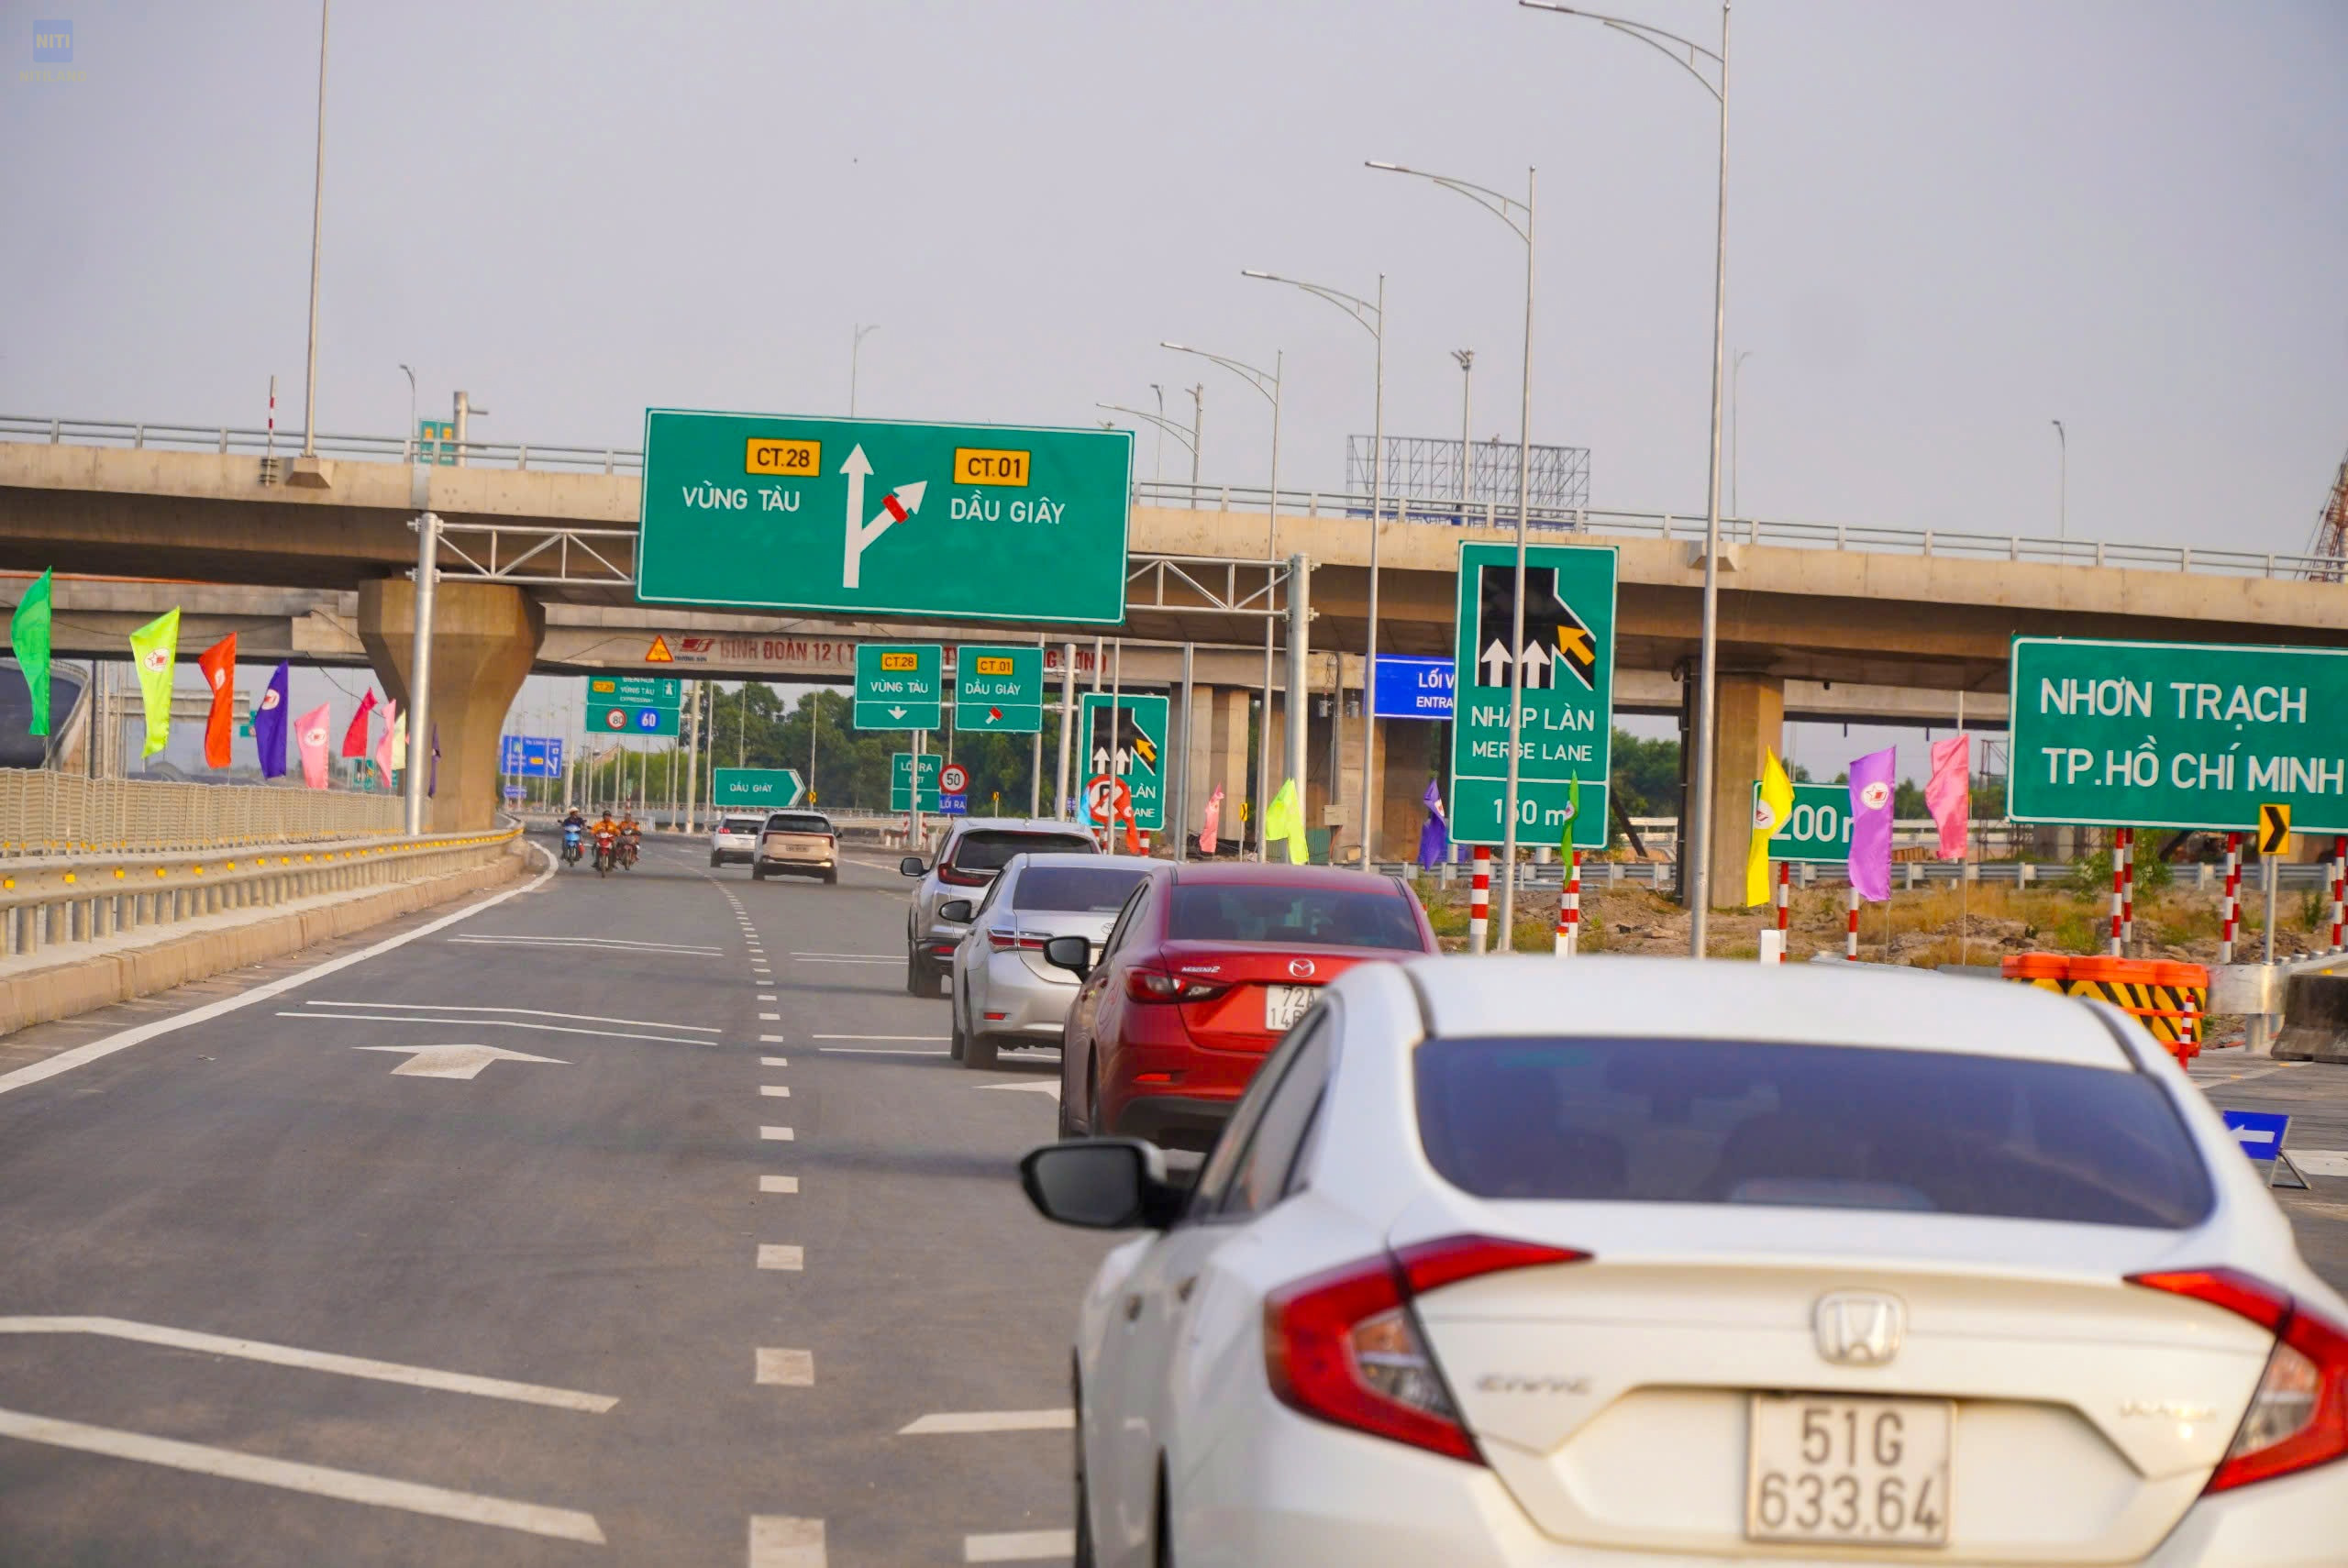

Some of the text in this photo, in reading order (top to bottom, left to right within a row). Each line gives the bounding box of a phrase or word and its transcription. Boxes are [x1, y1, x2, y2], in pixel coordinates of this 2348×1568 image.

[757, 448, 810, 469] CT.28
[968, 458, 1022, 479] CT.01
[682, 480, 800, 512] VŨNG TÀU
[951, 490, 1065, 525] DẦU GIÂY
[763, 638, 807, 661] ĐOÀN
[813, 643, 831, 661] 12
[884, 657, 914, 668] CT.28
[980, 660, 1011, 671] CT.01
[907, 679, 928, 693] TÀU
[965, 679, 1021, 696] DẦU GIÂY
[1418, 668, 1442, 689] LỐI
[1416, 696, 1453, 709] ENTRA
[2040, 676, 2308, 731] NHƠN TRẠCH
[642, 712, 656, 727] 60
[1544, 702, 1594, 732] LÀN
[1543, 744, 1592, 762] LANE
[919, 763, 933, 772] RA
[2042, 734, 2345, 795] TP.HỒ CHÍ MINH
[752, 783, 773, 792] GIÂY
[947, 773, 960, 786] 50
[955, 801, 966, 809] RA
[1134, 808, 1155, 818] ANE
[1493, 798, 1537, 825] 10
[1800, 1408, 1905, 1466] 51G
[1759, 1474, 1944, 1535] 633.64
